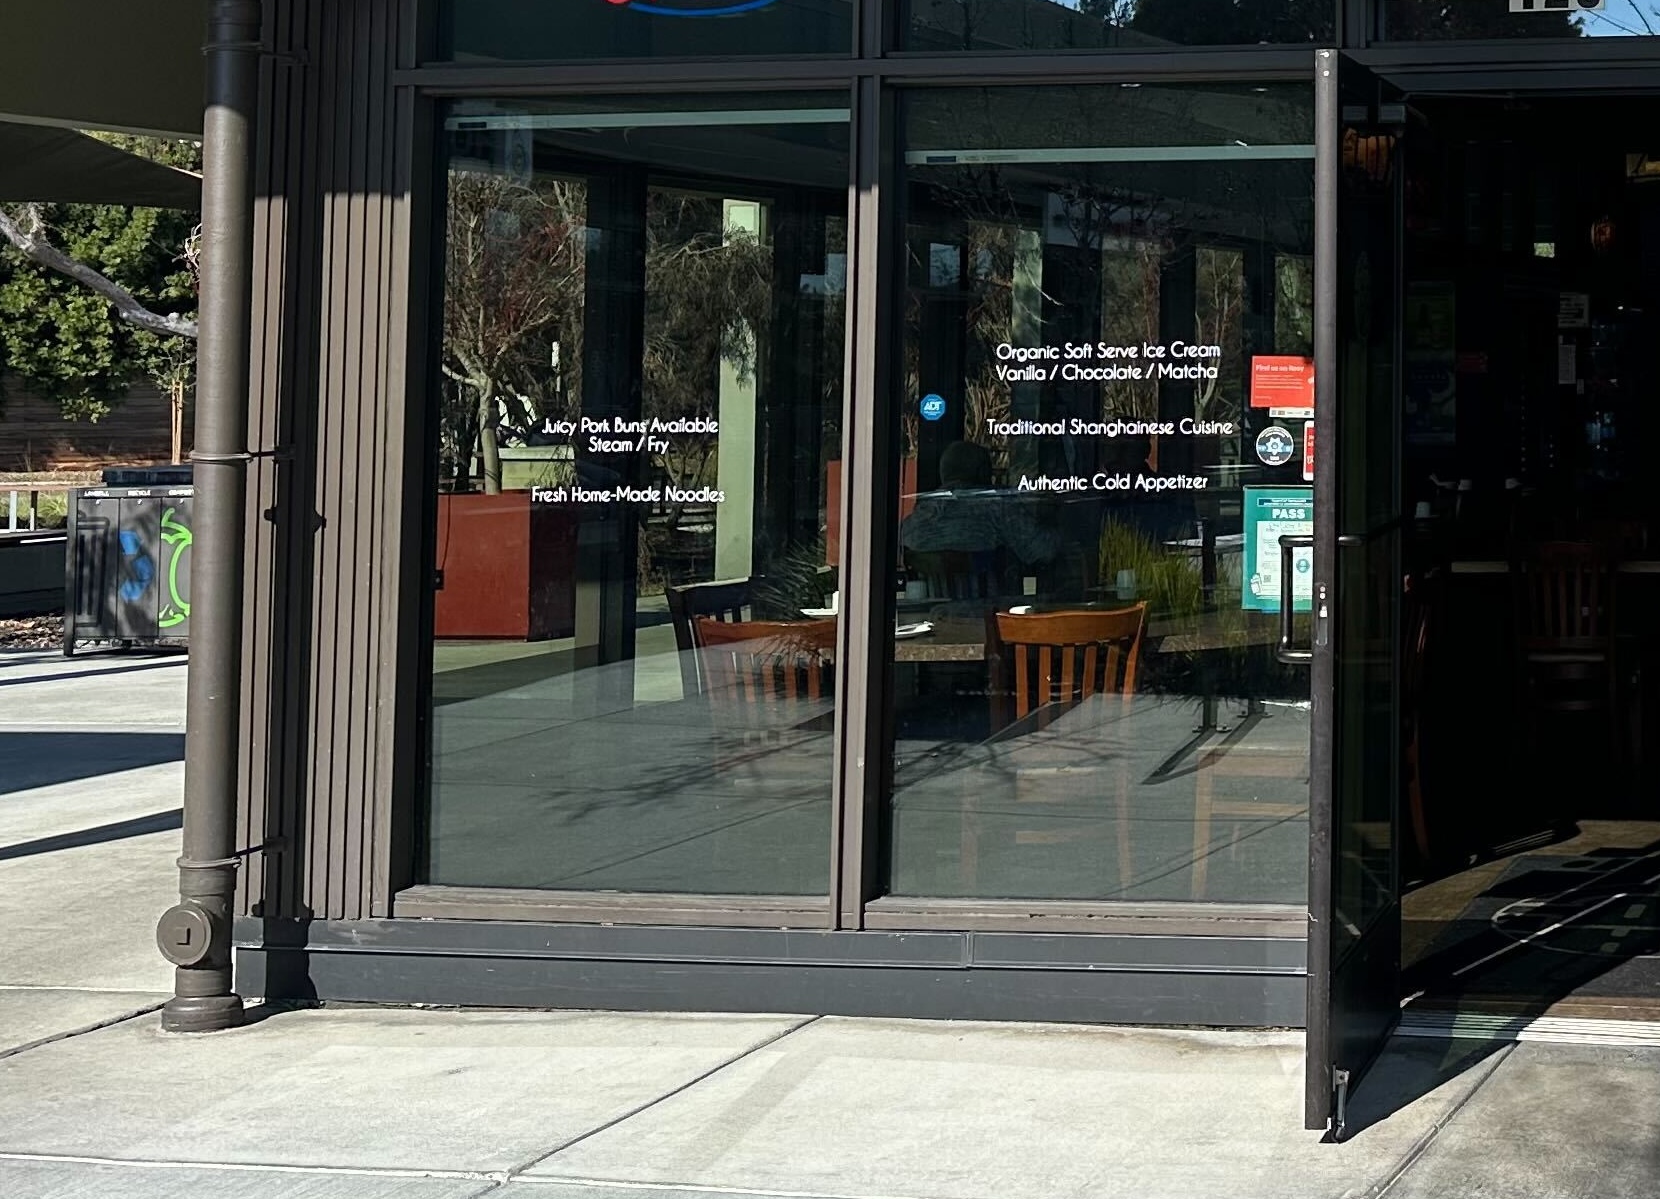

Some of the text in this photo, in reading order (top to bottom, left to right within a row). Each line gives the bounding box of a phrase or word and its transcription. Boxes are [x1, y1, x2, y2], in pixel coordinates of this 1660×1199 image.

[996, 341, 1221, 362] Organic Soft Serve Ice Cream
[995, 363, 1218, 381] Vanilla / Chocolate / Matcha
[924, 401, 942, 411] ADT
[541, 417, 719, 437] Juicy Pork Buns Available
[986, 417, 1233, 438] Traditional Shanghainese Cuisine
[588, 435, 670, 455] Steam / Fry
[1017, 473, 1208, 492] Authentic Cold Appetizer
[531, 485, 725, 503] Fresh Home-Made Noodles
[1272, 508, 1306, 519] PASS
